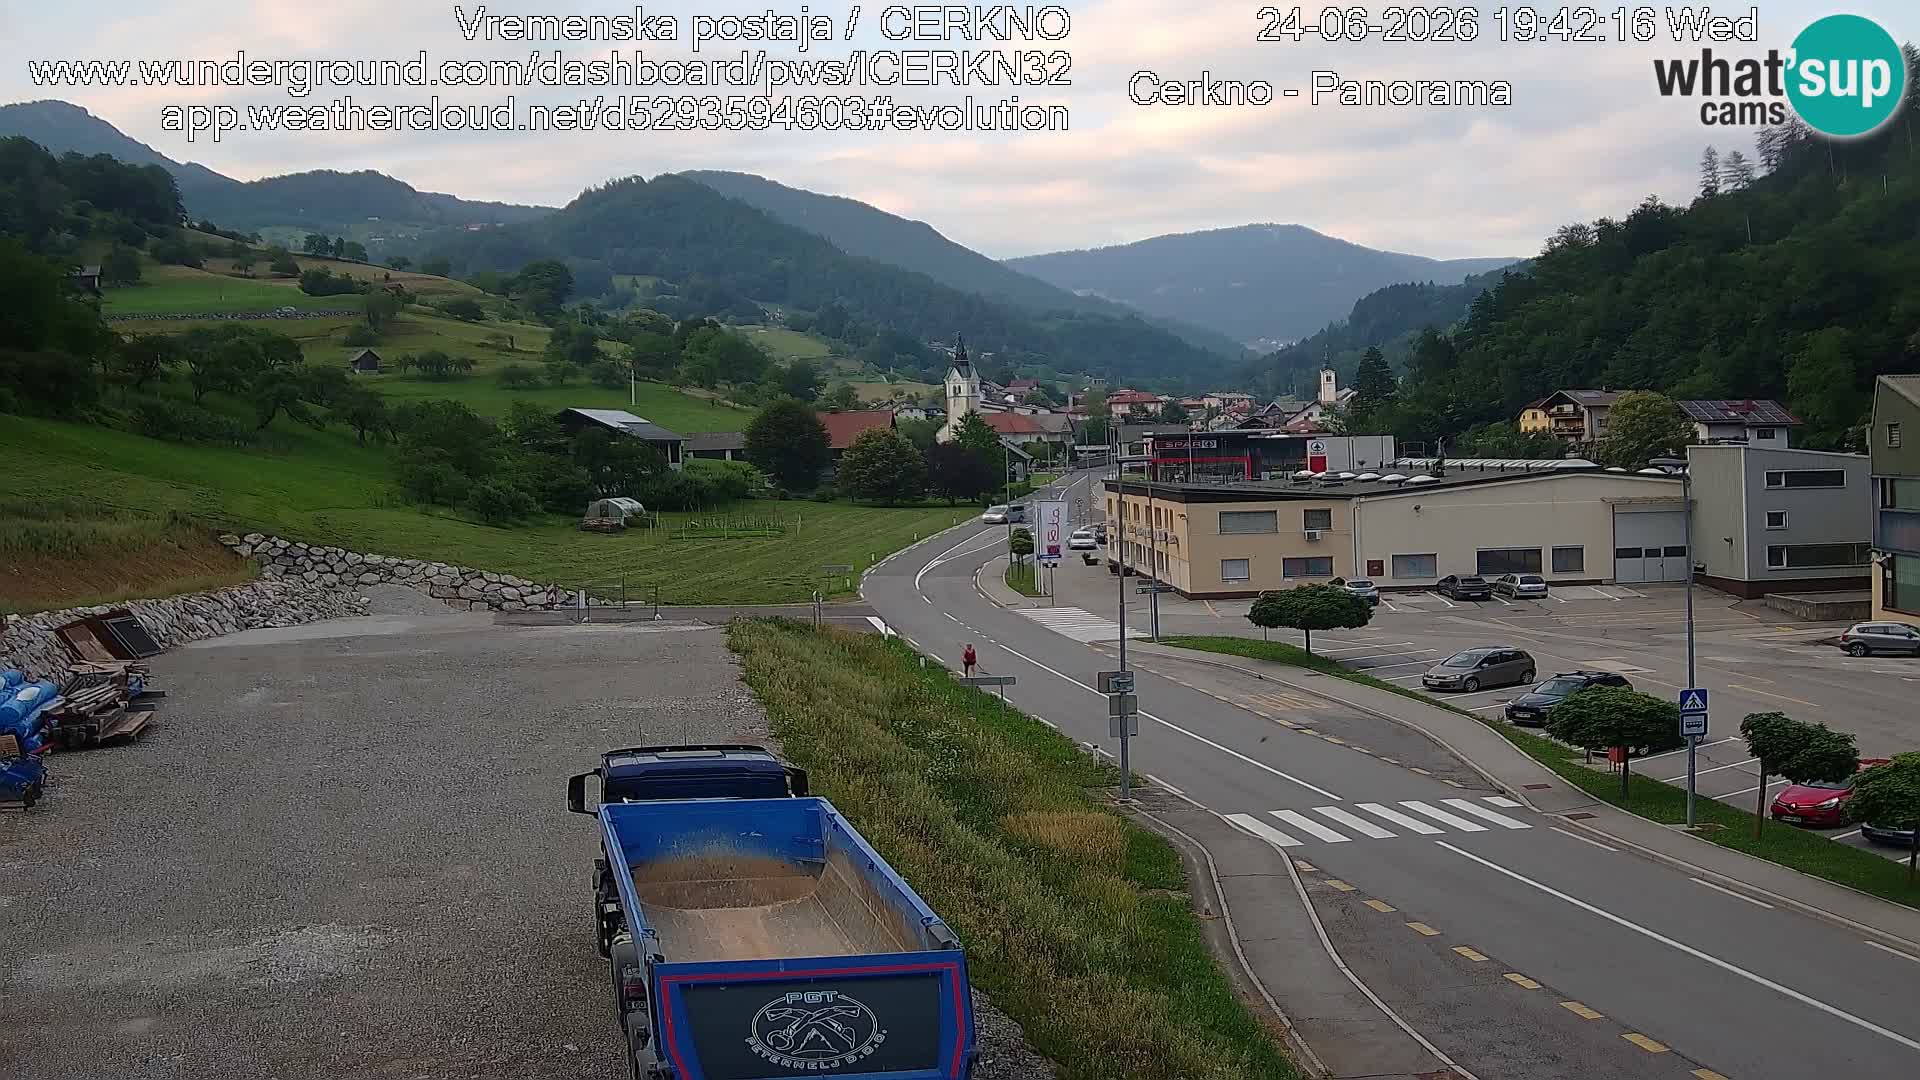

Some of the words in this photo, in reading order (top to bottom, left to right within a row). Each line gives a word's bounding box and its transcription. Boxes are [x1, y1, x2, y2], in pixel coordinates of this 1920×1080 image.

[1165, 440, 1201, 449] SPAR
[785, 990, 838, 1004] PGT
[745, 1036, 840, 1070] PETERNELJ
